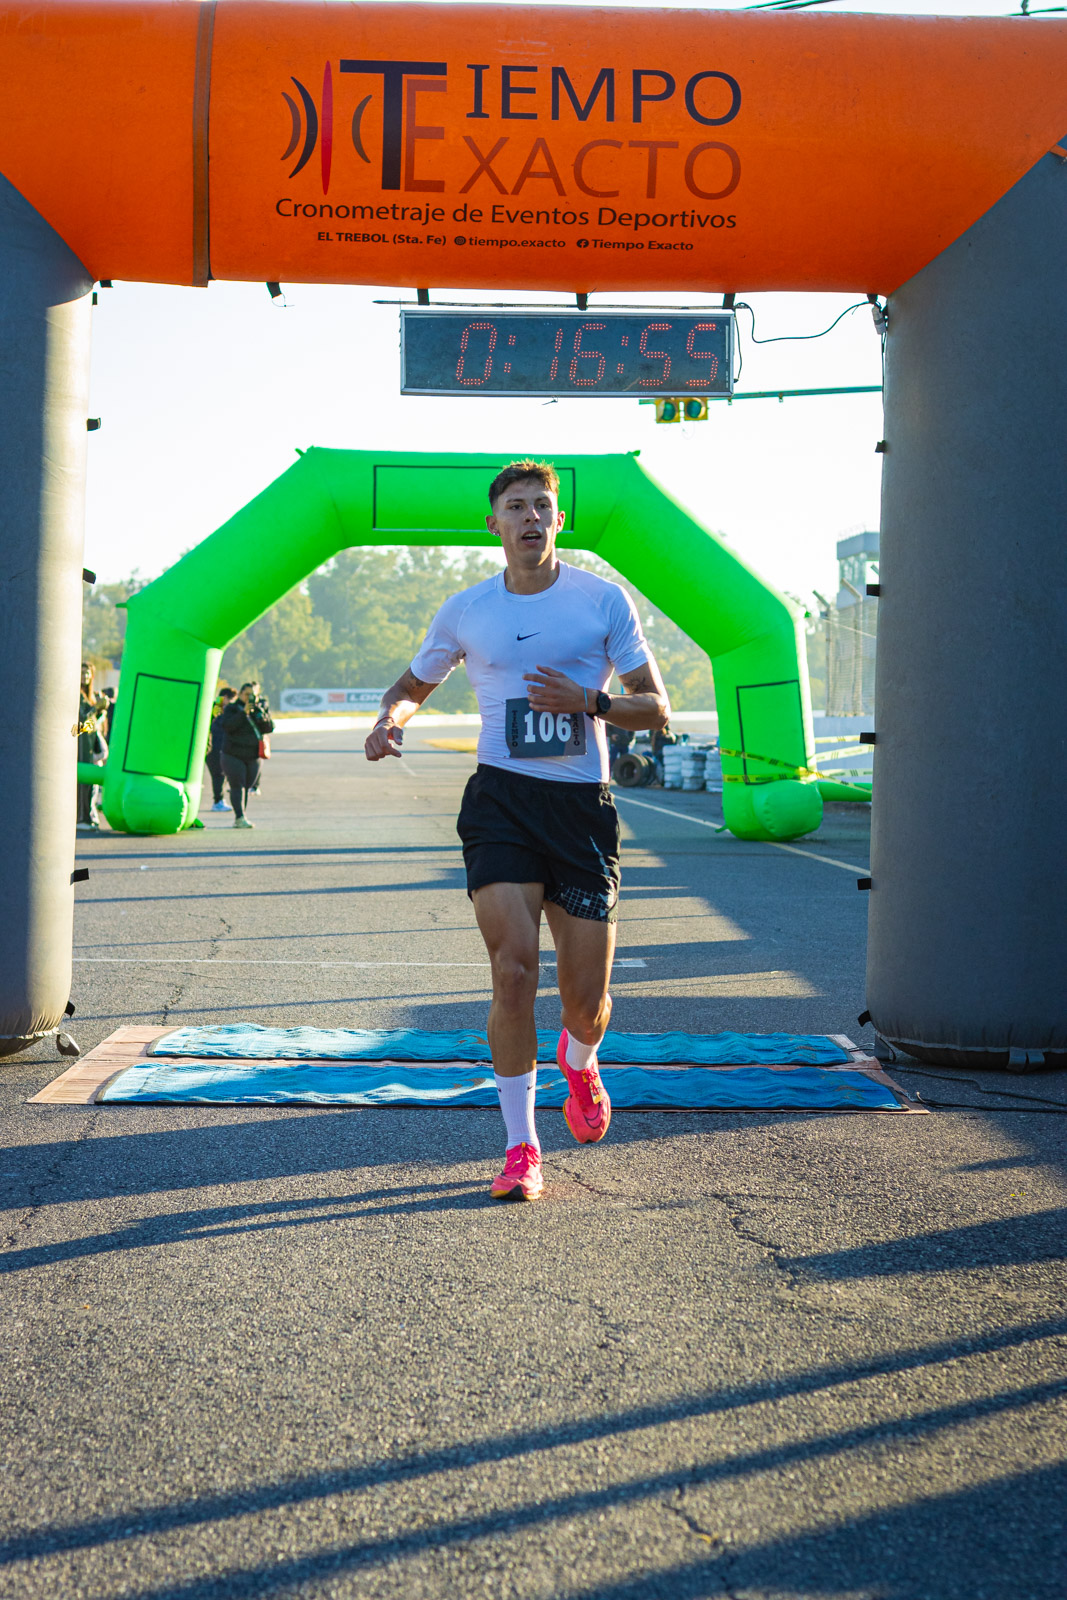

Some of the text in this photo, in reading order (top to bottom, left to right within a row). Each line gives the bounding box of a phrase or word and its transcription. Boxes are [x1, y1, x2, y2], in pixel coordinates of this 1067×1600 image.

[275, 198, 737, 230] Cronometraje de Eventos Deportivos
[317, 232, 694, 251] EL TREBOL (Sta. Fe) tiempo.exacto Tiempo Exacto
[524, 711, 571, 742] 106
